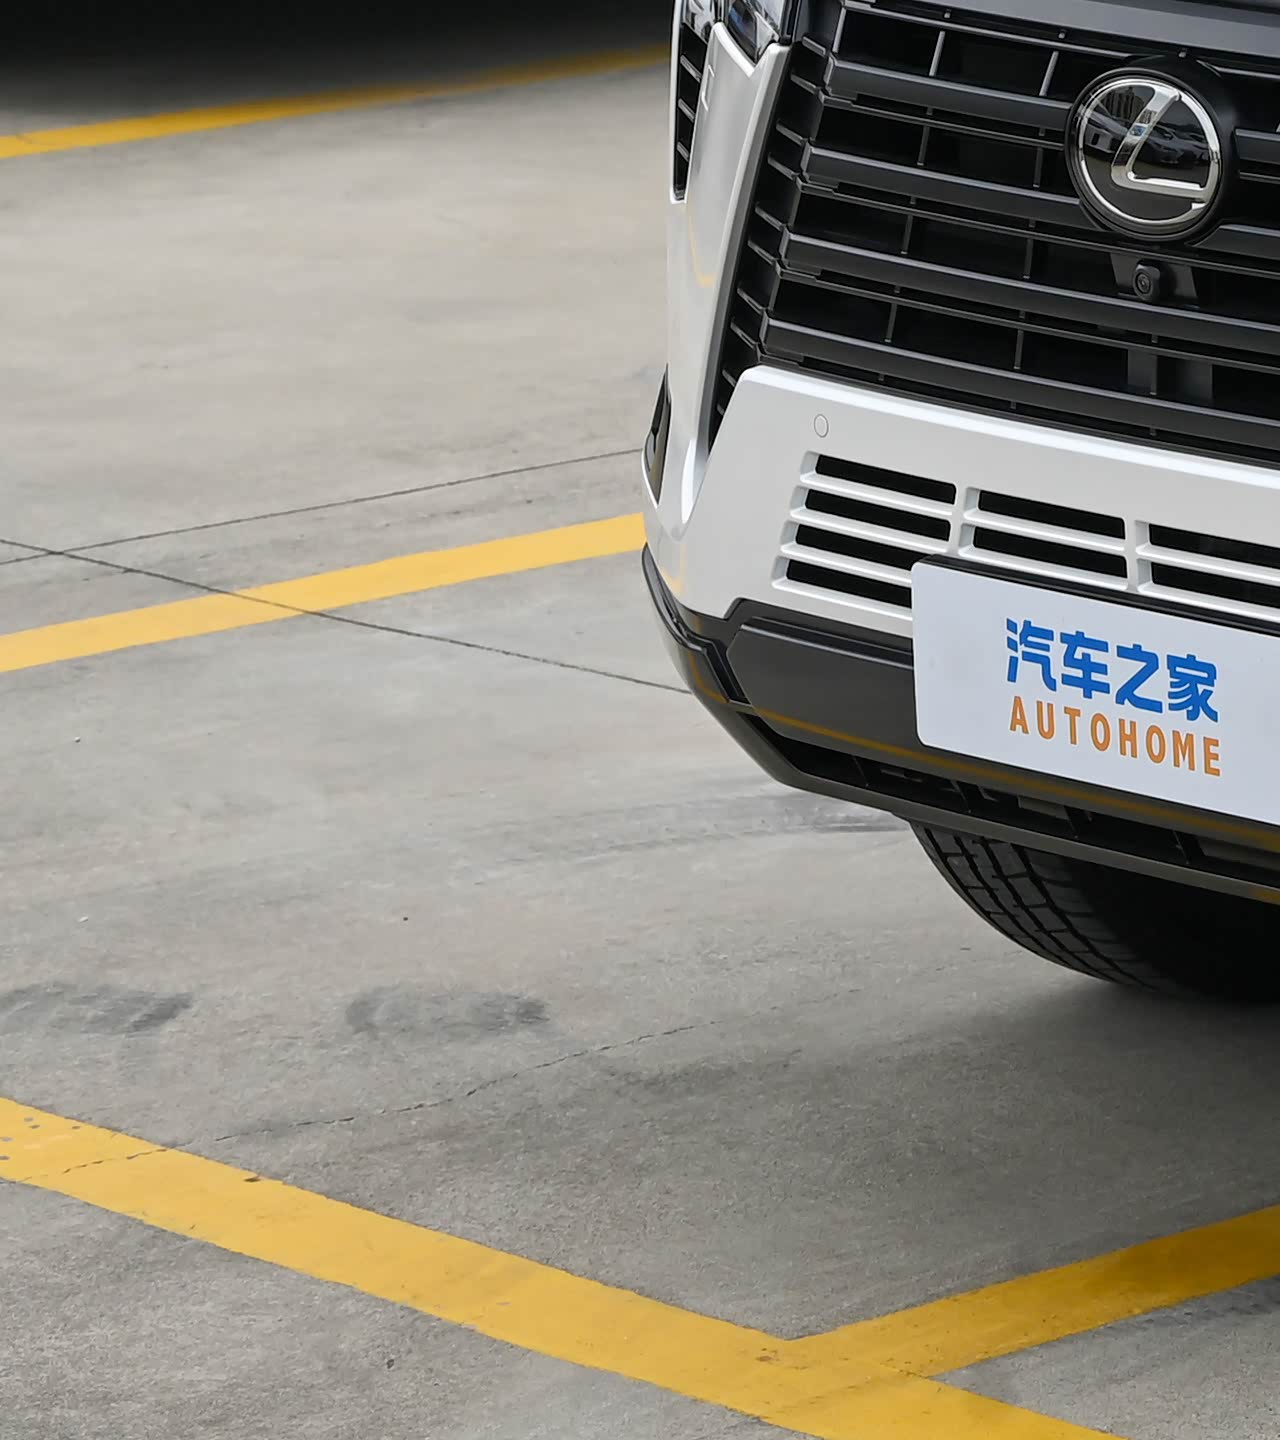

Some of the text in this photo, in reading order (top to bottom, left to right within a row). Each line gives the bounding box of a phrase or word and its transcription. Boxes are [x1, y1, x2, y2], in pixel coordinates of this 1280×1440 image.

[1005, 616, 1219, 724] 汽车之家
[1008, 694, 1222, 778] AUTOHOME
